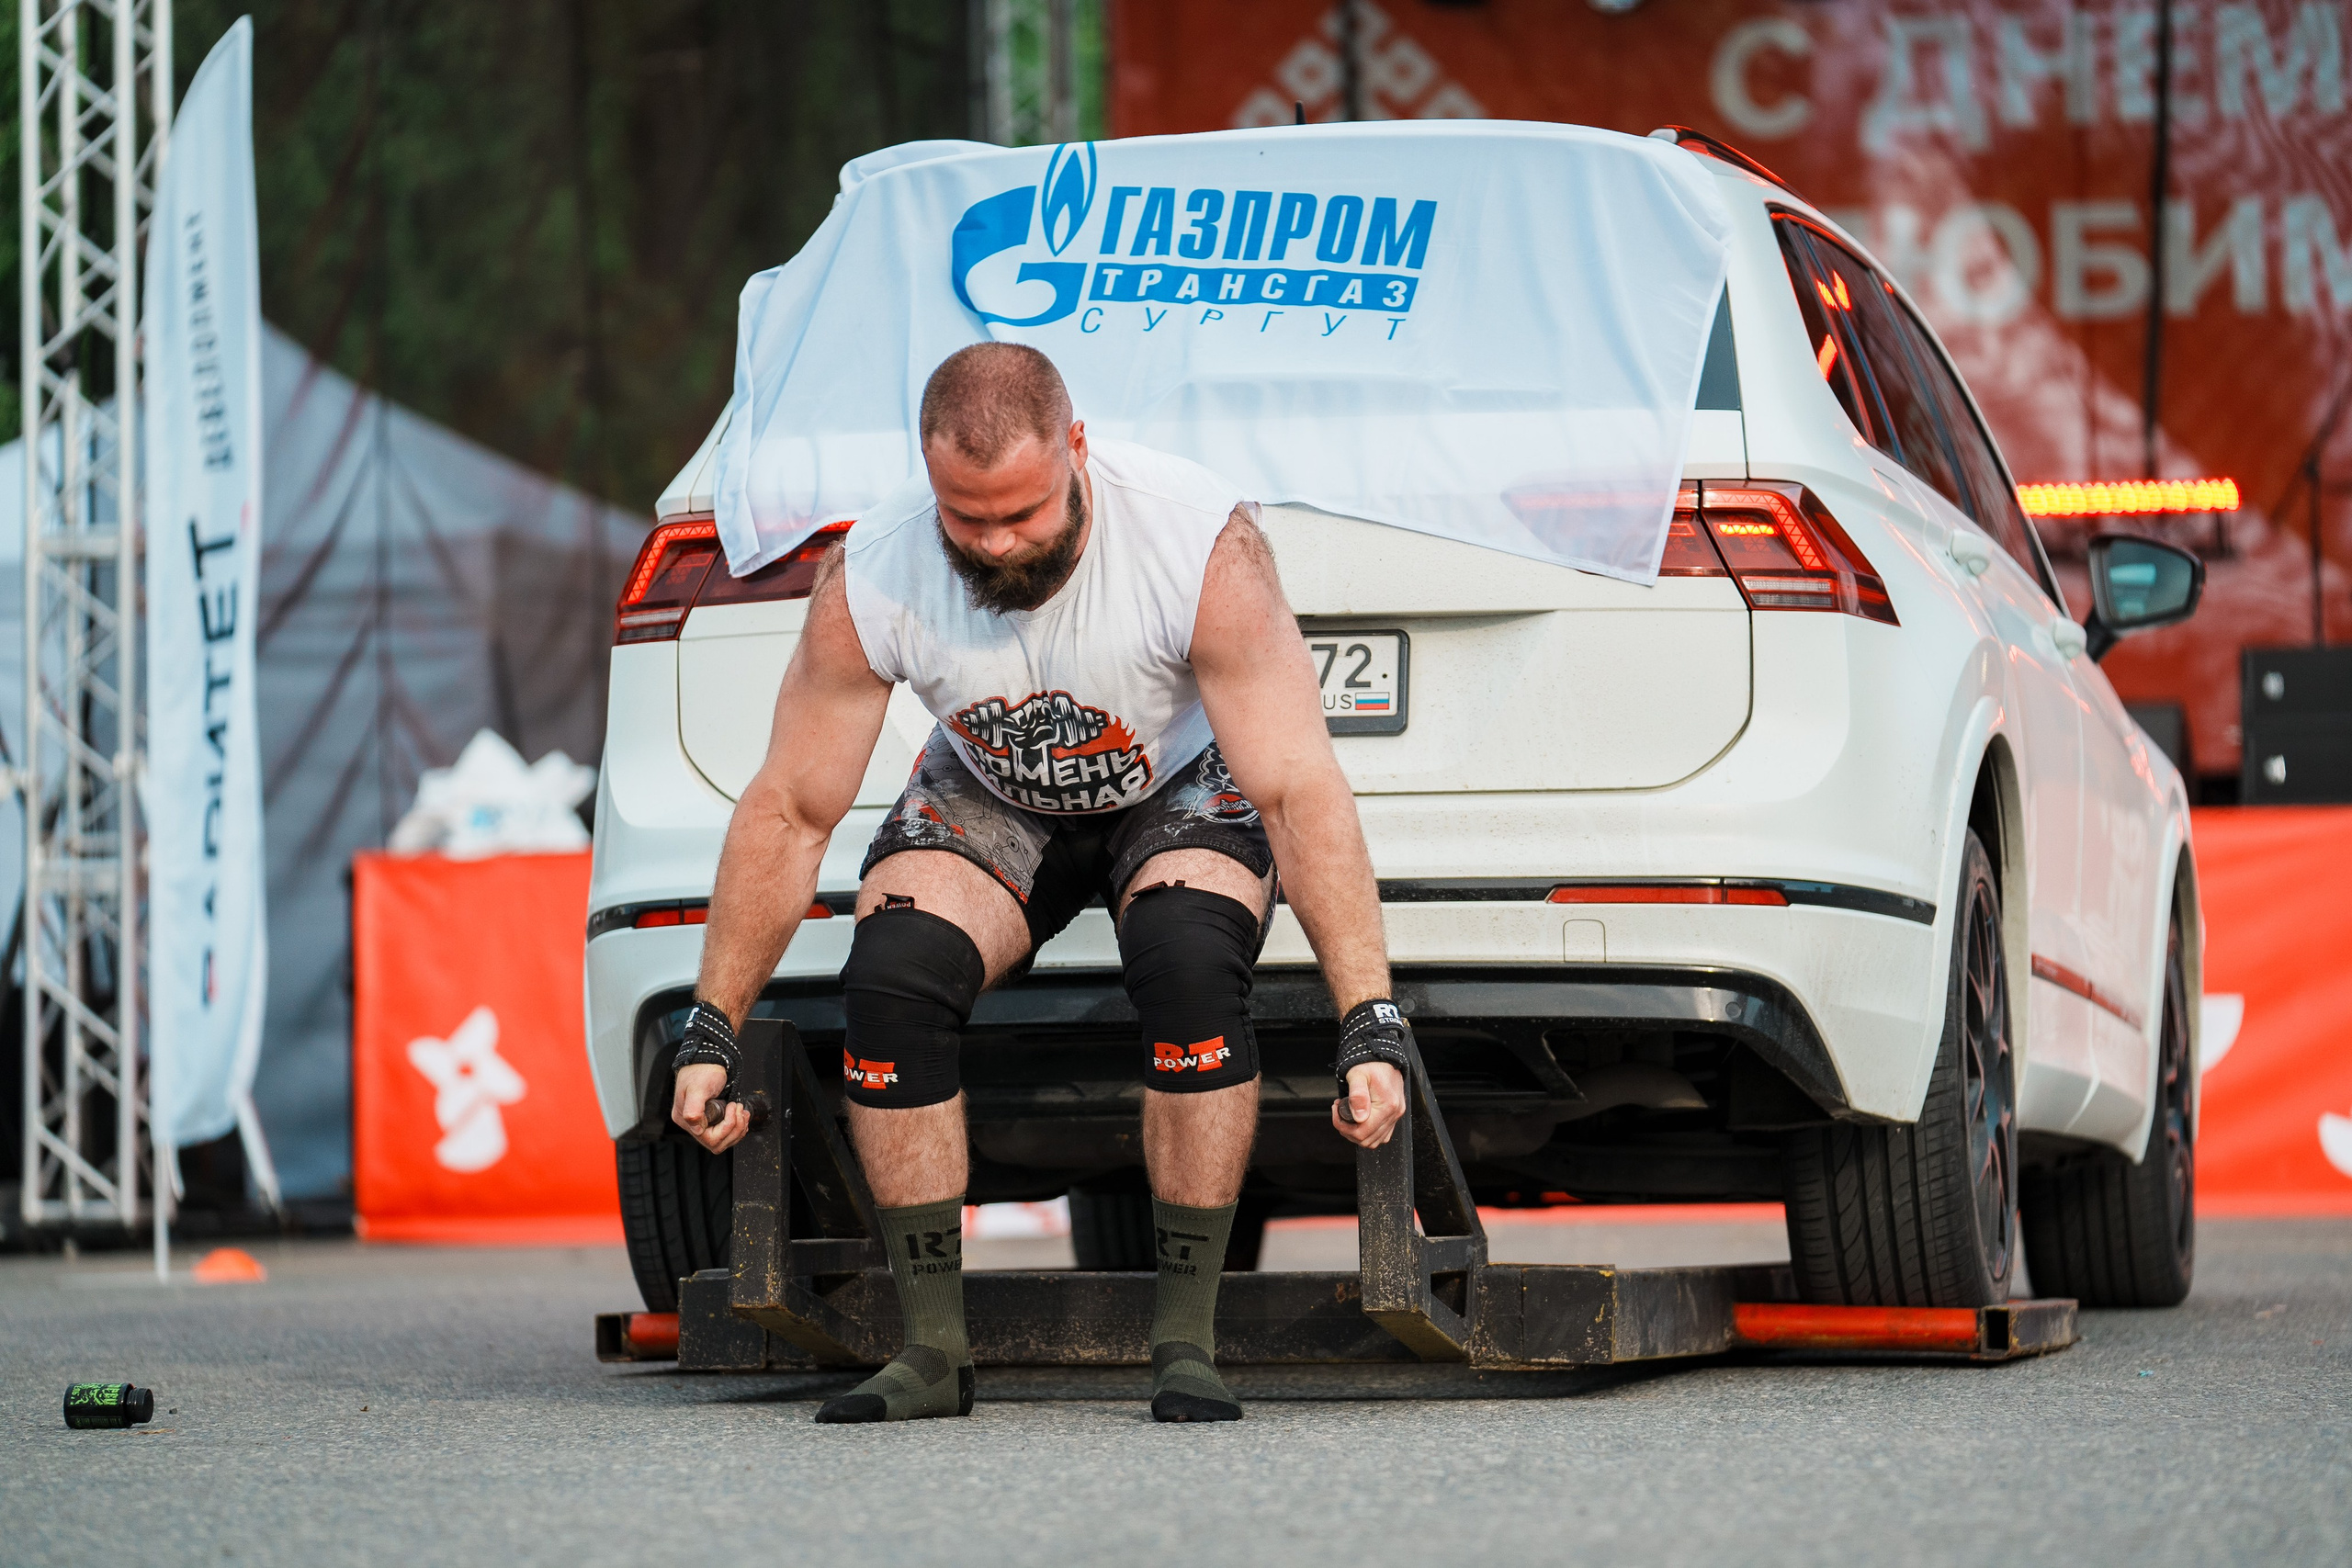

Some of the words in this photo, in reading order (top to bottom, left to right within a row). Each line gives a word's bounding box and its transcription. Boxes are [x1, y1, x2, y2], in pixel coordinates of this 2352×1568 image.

[1711, 18, 1815, 140] С
[1859, 5, 2345, 156] ДНЕМ
[1100, 186, 1438, 270] ГАЗПРОМ
[1102, 268, 1408, 308] ТРАНСГАЗ
[1080, 307, 1407, 341] СУРГУТ
[1311, 643, 1372, 689] 72
[1153, 1047, 1231, 1068] POWER
[1154, 1035, 1225, 1073] RT
[844, 1066, 899, 1083] OWER
